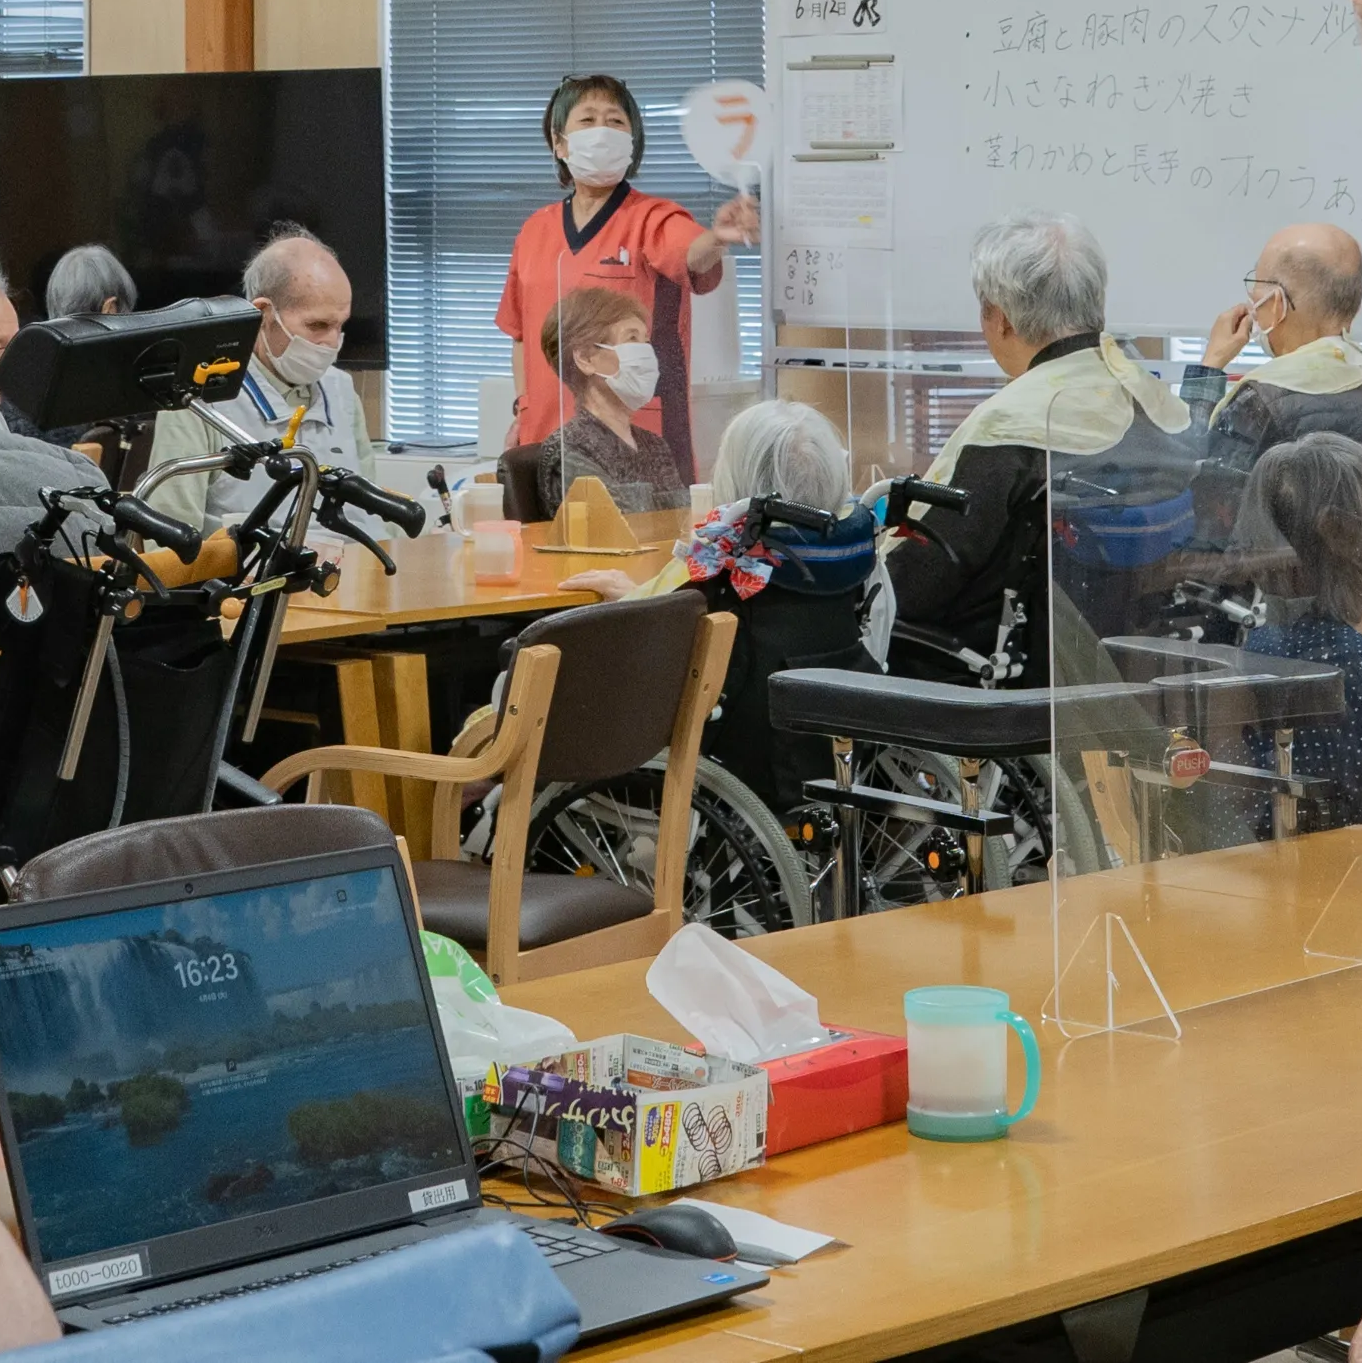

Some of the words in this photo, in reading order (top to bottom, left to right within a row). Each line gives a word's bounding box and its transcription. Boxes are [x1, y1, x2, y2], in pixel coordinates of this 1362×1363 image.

[984, 70, 1253, 118] 小さなねぎ焼き
[786, 249, 799, 263] A
[785, 286, 795, 300] C
[802, 288, 814, 305] 18
[1177, 755, 1206, 772] PUSH
[174, 953, 238, 988] 16:23
